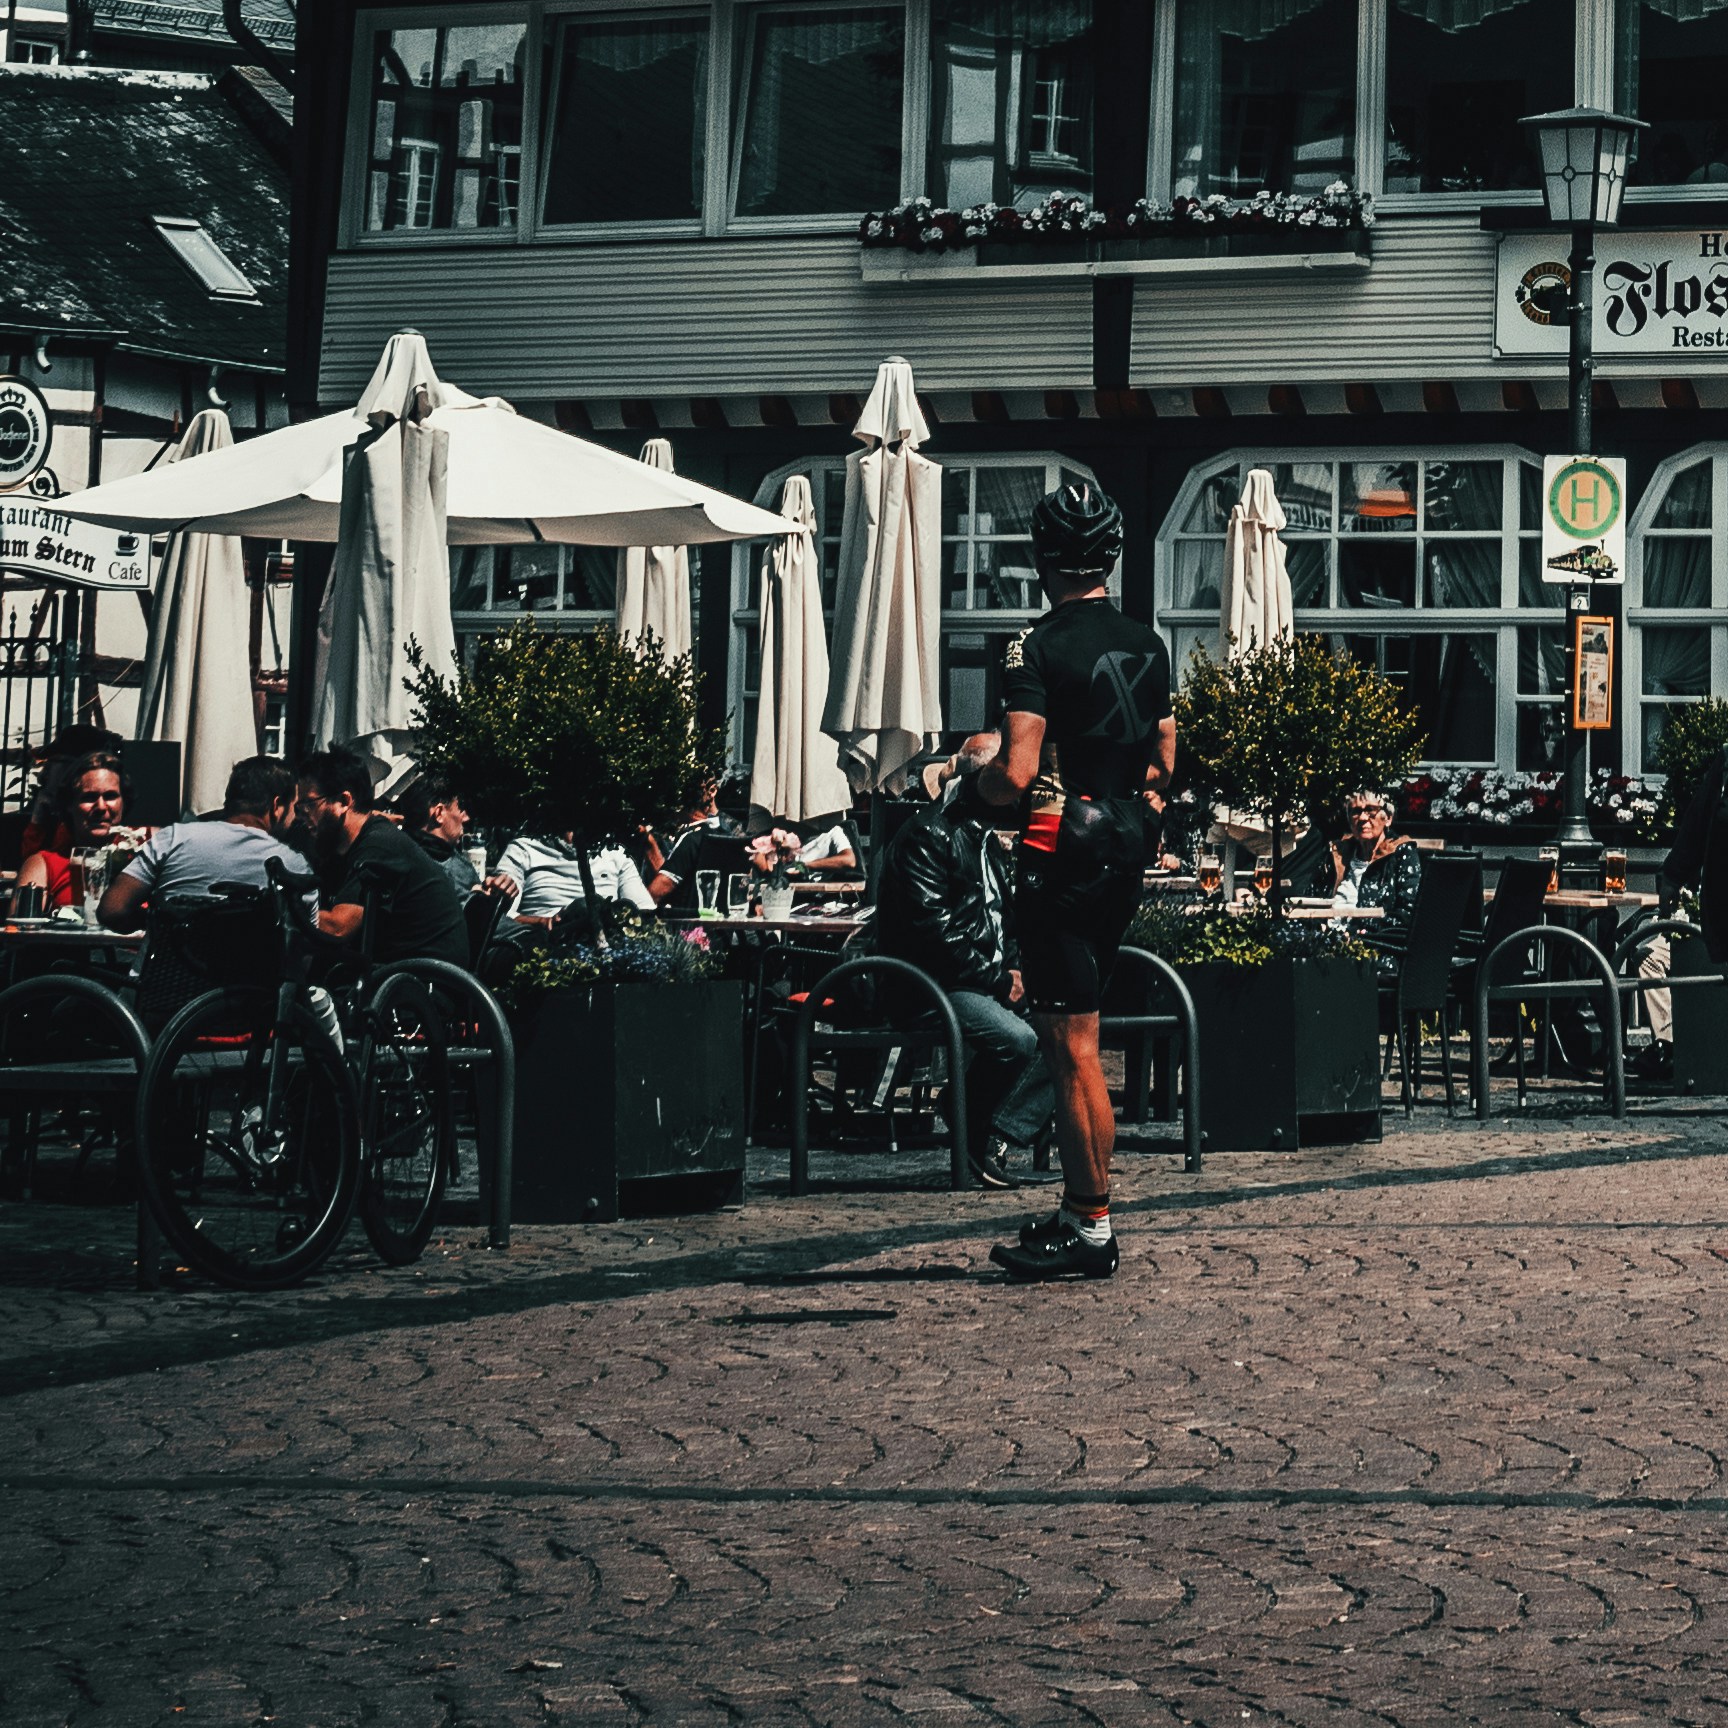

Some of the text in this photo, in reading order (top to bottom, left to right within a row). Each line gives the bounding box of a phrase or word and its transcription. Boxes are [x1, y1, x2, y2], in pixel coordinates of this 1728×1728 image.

[1571, 479, 1600, 522] H
[34, 536, 96, 574] Stern
[108, 561, 142, 581] Cafe
